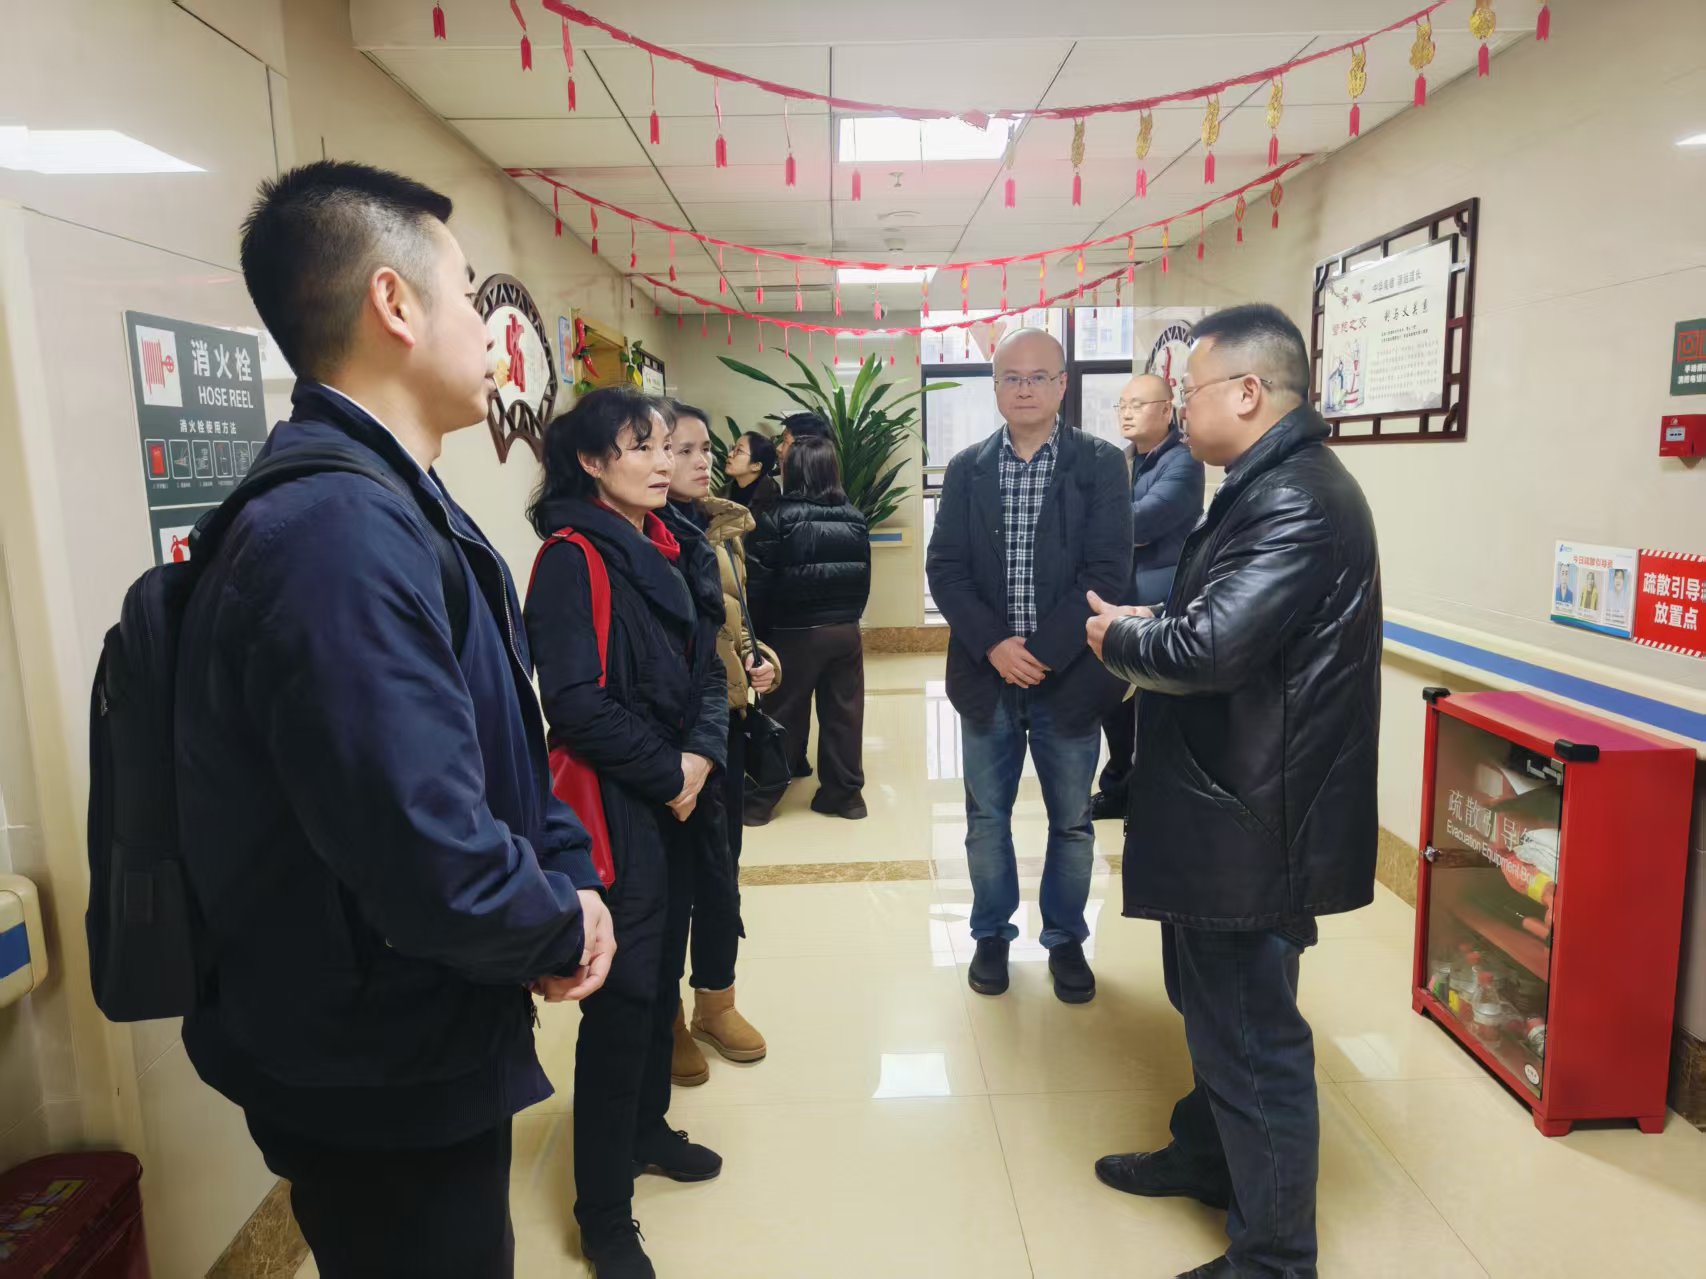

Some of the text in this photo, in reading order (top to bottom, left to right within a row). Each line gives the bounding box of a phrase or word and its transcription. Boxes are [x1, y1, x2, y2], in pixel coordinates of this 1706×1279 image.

[190, 339, 253, 381] 消火栓
[198, 385, 254, 409] HOSE REEL
[179, 418, 237, 435] 消火栓使用方法
[1643, 572, 1706, 602] 疏散引导
[1654, 601, 1699, 631] 放置点
[1448, 789, 1531, 852] 疏散引导
[1447, 819, 1481, 853] Evacuation
[1481, 841, 1520, 879] Equipment
